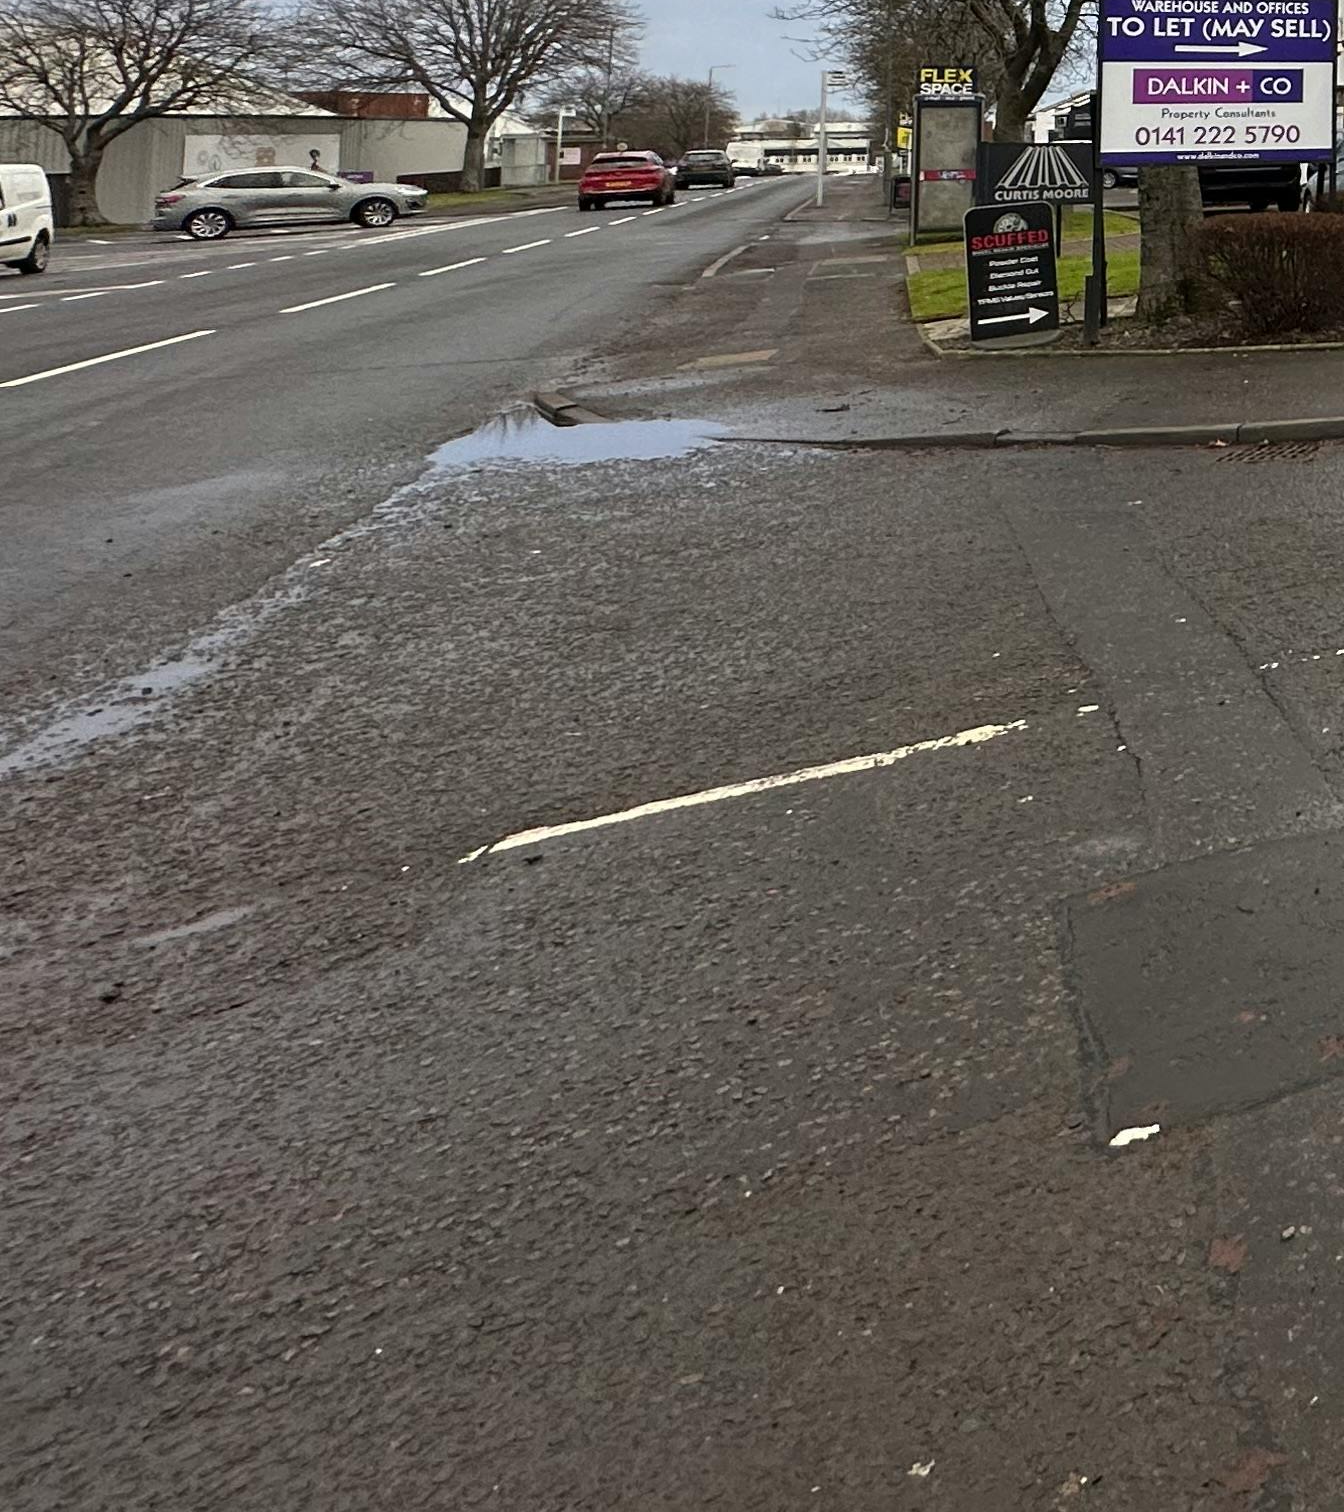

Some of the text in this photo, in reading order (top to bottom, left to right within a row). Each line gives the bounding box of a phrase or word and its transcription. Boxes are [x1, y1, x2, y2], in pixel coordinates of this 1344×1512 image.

[1131, 0, 1309, 15] WAREHOUSE AND OFFICES
[1106, 16, 1331, 42] TO LET (MAY SELL)
[920, 68, 973, 83] FLEX
[920, 83, 973, 95] SPACE
[1147, 77, 1292, 96] DALKIN + CO
[1161, 107, 1276, 120] Property Consultants
[1135, 124, 1300, 146] 0141 222 5790
[994, 188, 1089, 201] CURTIS MOORE
[971, 229, 1049, 250] SCUFFED
